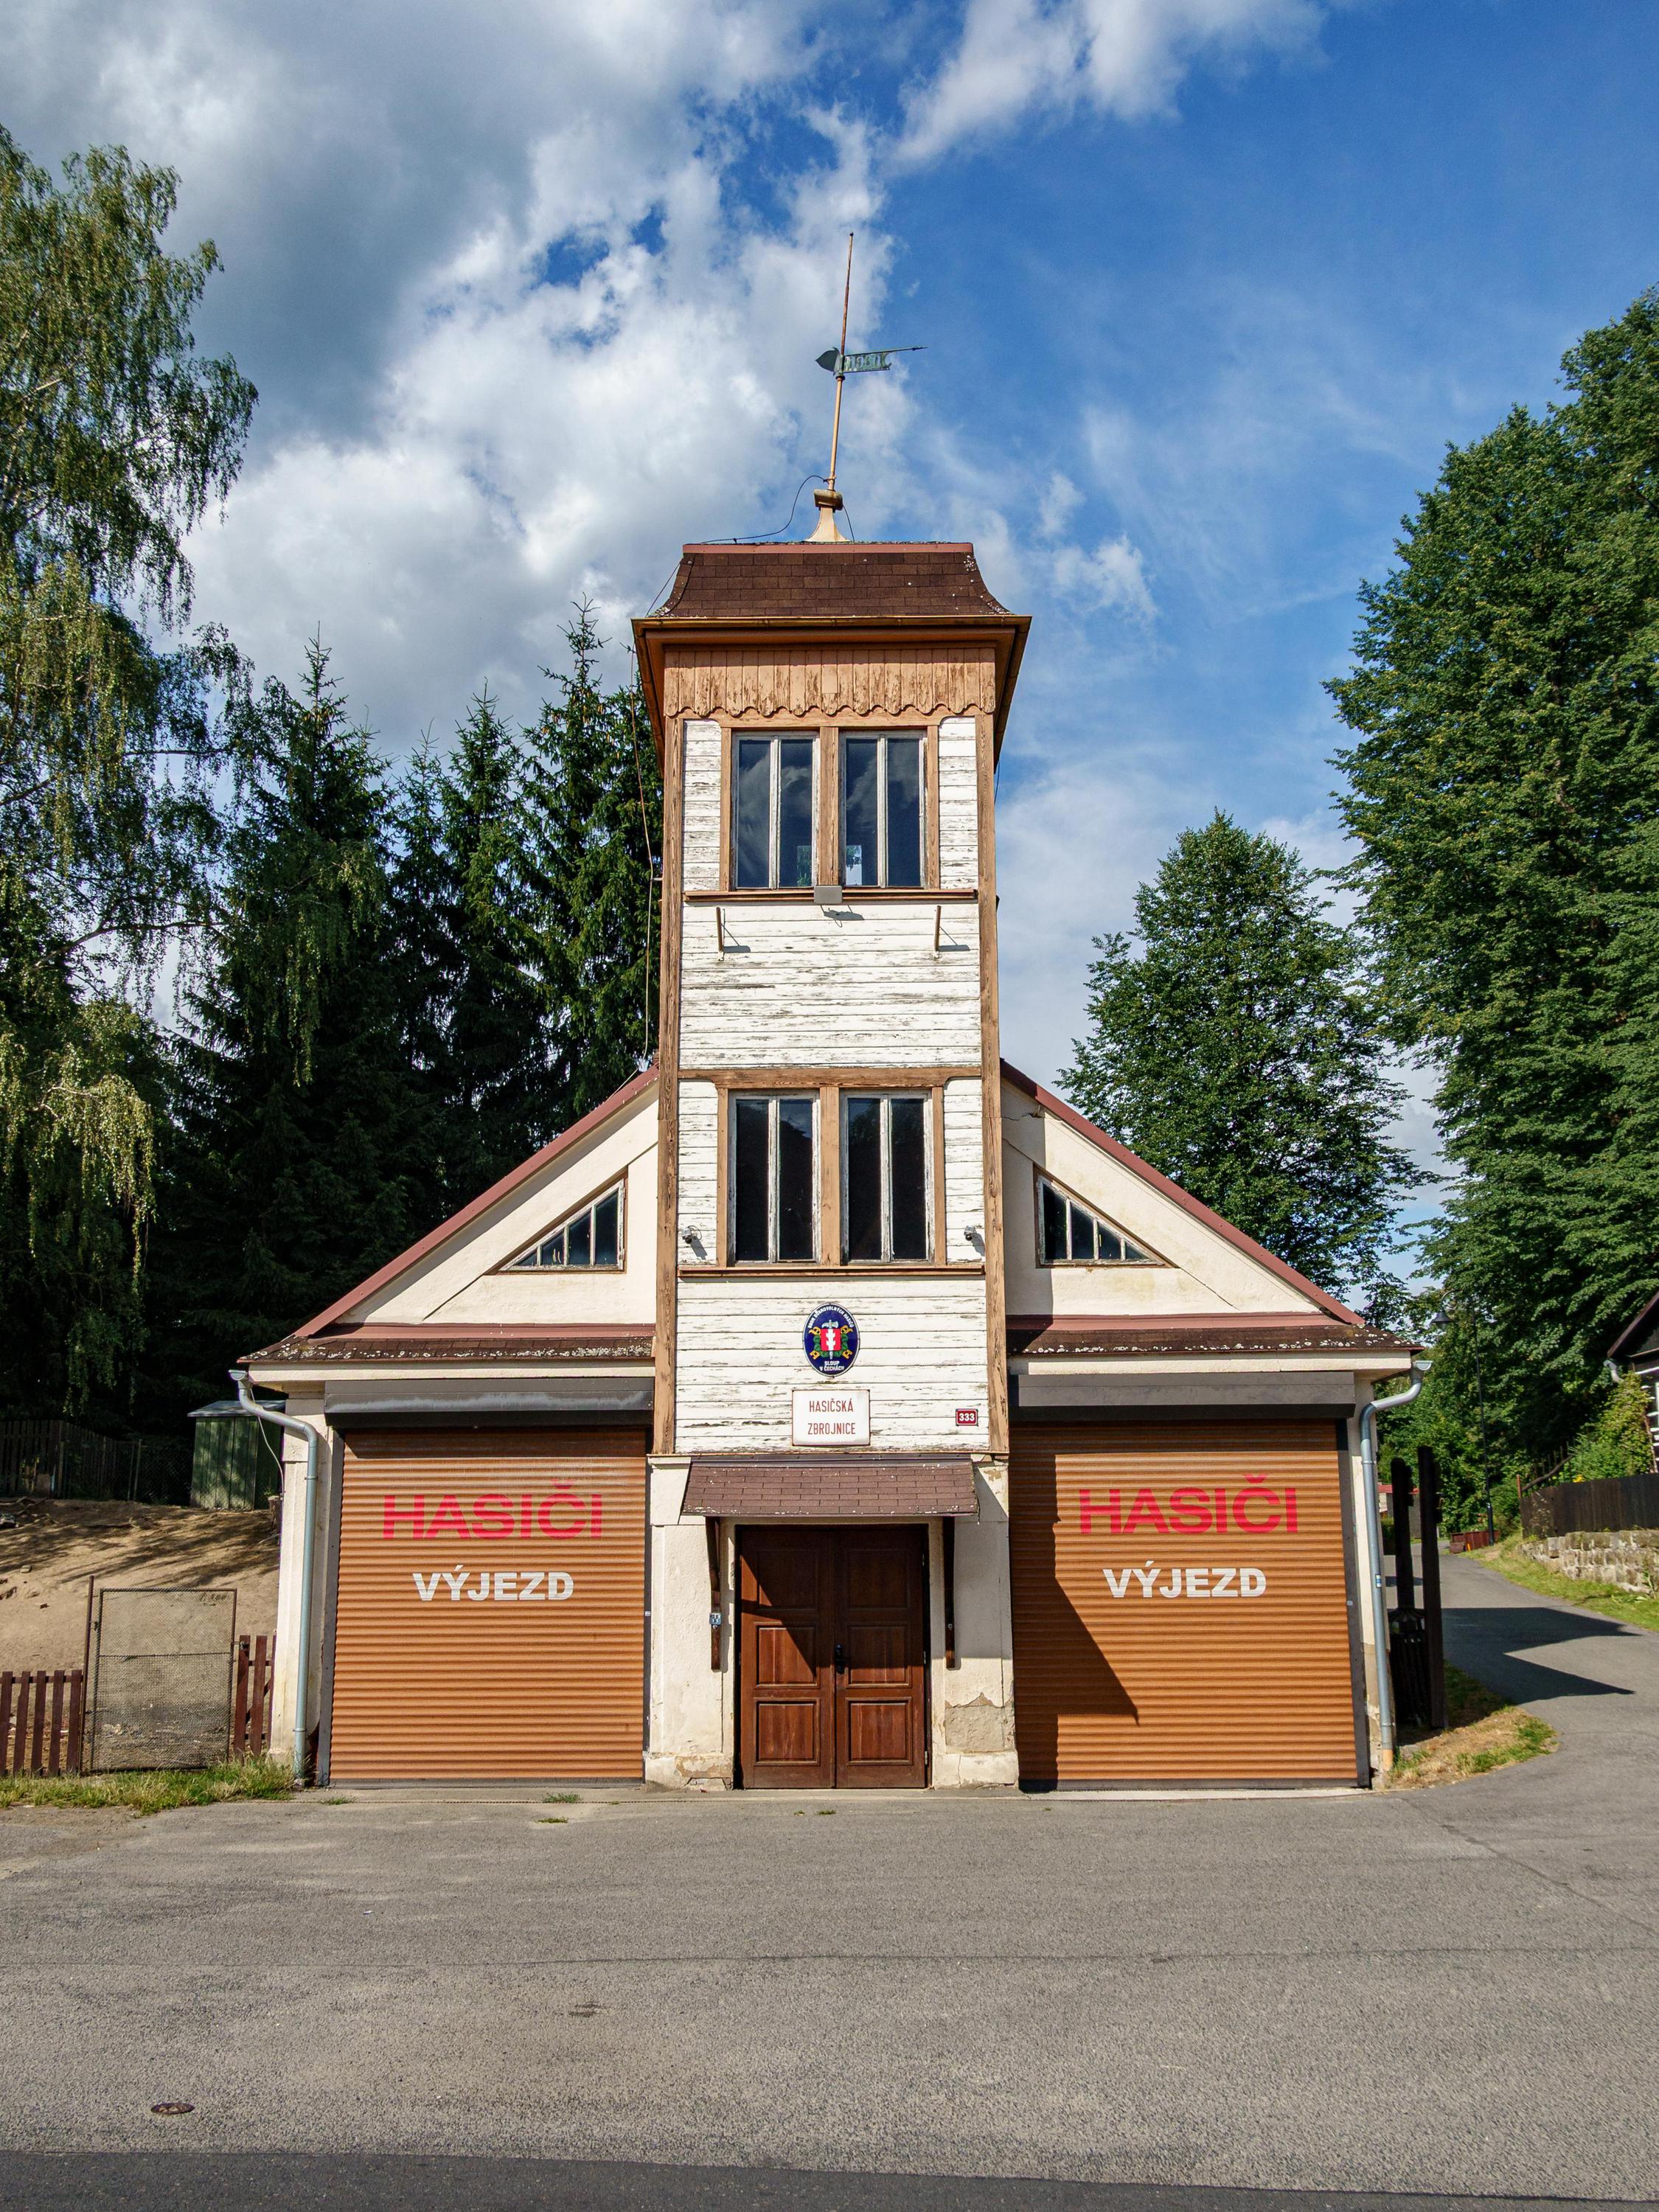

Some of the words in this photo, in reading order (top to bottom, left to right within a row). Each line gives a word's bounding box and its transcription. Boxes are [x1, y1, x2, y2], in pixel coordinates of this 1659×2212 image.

[809, 1397, 854, 1413] HASIČSKÁ
[959, 1413, 975, 1422] 333
[807, 1422, 856, 1435] ZBROJNICE
[383, 1479, 602, 1540] HASIČI
[1079, 1474, 1298, 1534] HASIČI
[412, 1565, 574, 1601] VÝJEZD
[1102, 1560, 1267, 1598] VÝJEZD
